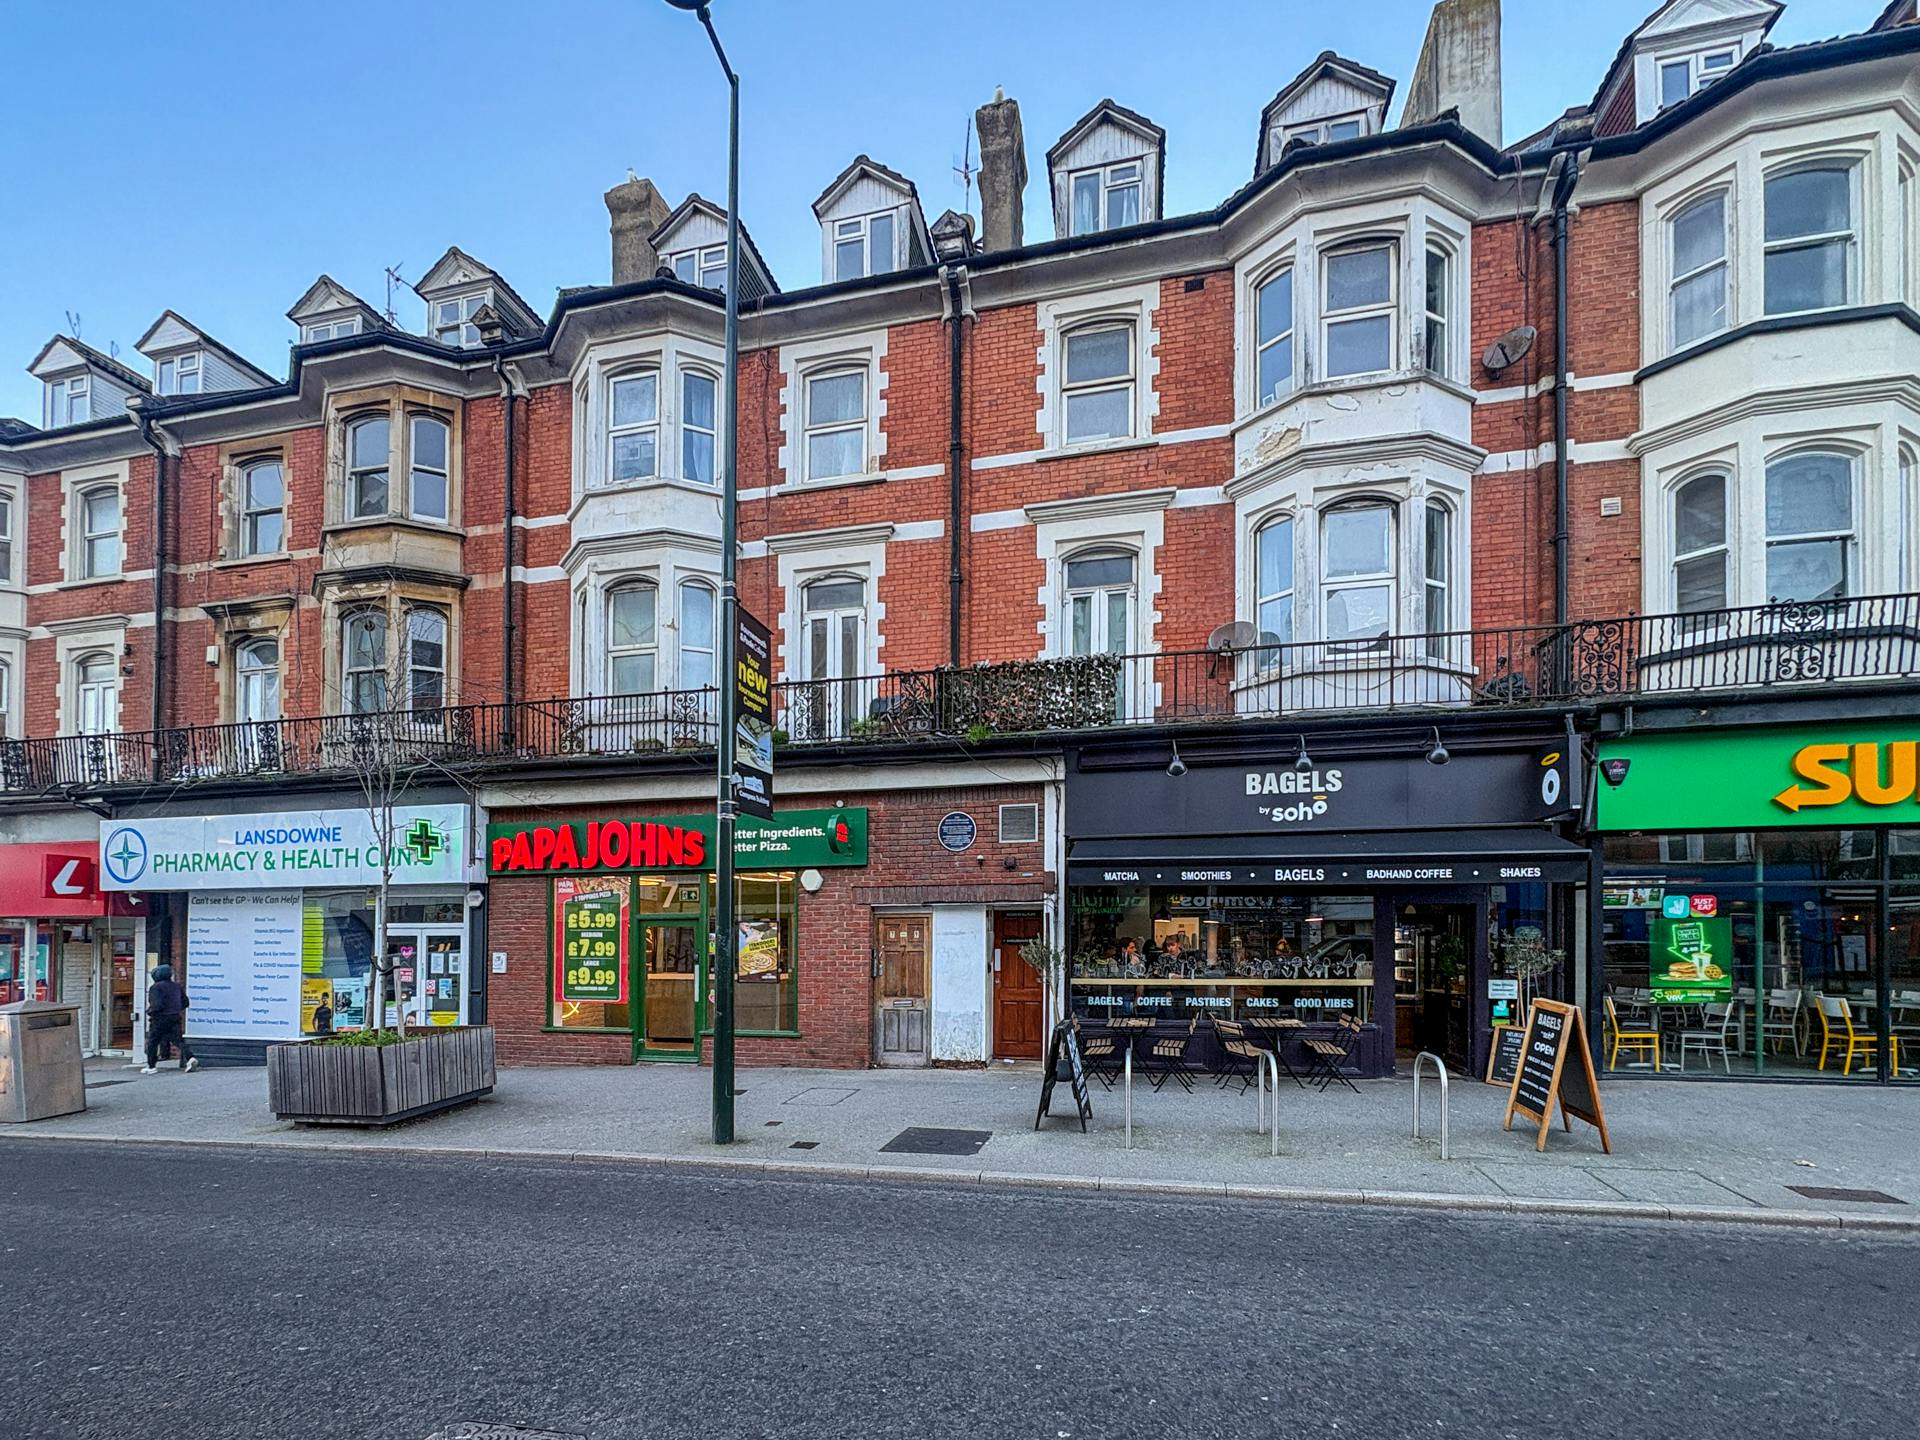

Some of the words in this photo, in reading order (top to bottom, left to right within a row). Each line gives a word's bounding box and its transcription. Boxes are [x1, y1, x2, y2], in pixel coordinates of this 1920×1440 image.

[738, 661, 768, 694] new
[1246, 769, 1342, 795] BAGELS
[1774, 741, 1920, 812] SU
[1259, 806, 1270, 815] by
[1271, 800, 1328, 822] soho
[235, 826, 342, 846] LANSDOWNE
[760, 826, 826, 840] Ingredients.
[492, 823, 579, 871] PAPA
[581, 820, 705, 869] JOHNS
[760, 841, 791, 852] Pizza.
[153, 850, 259, 874] PHARMACY
[263, 850, 276, 870] &
[282, 847, 360, 870] HEALTH
[365, 846, 433, 868] CIN
[1104, 871, 1139, 881] MATCHA
[1180, 871, 1232, 881] SMOOTHIES
[1275, 869, 1325, 881] BAGELS
[1366, 869, 1412, 879] BADHAND
[1414, 869, 1453, 879] COFFEE
[1500, 868, 1541, 877] SHAKES
[191, 896, 209, 905] Can't
[210, 897, 221, 905] see
[222, 896, 234, 905] the
[235, 896, 246, 905] GP
[252, 896, 264, 905] We
[264, 896, 279, 904] Can
[280, 895, 300, 906] Help!
[661, 881, 678, 908] 7
[568, 910, 616, 928] £5.99
[568, 939, 616, 957] £7.99
[568, 967, 616, 985] £9.99
[1087, 996, 1123, 1006] BAGELS
[1137, 996, 1172, 1006] COFFEE
[1185, 997, 1232, 1007] PASTRIES
[1246, 997, 1279, 1007] CAKES
[1294, 998, 1321, 1008] GOOD
[1324, 998, 1354, 1008] VIBES
[1537, 1013, 1562, 1031] BAGELS
[1534, 1041, 1555, 1056] OPEN
